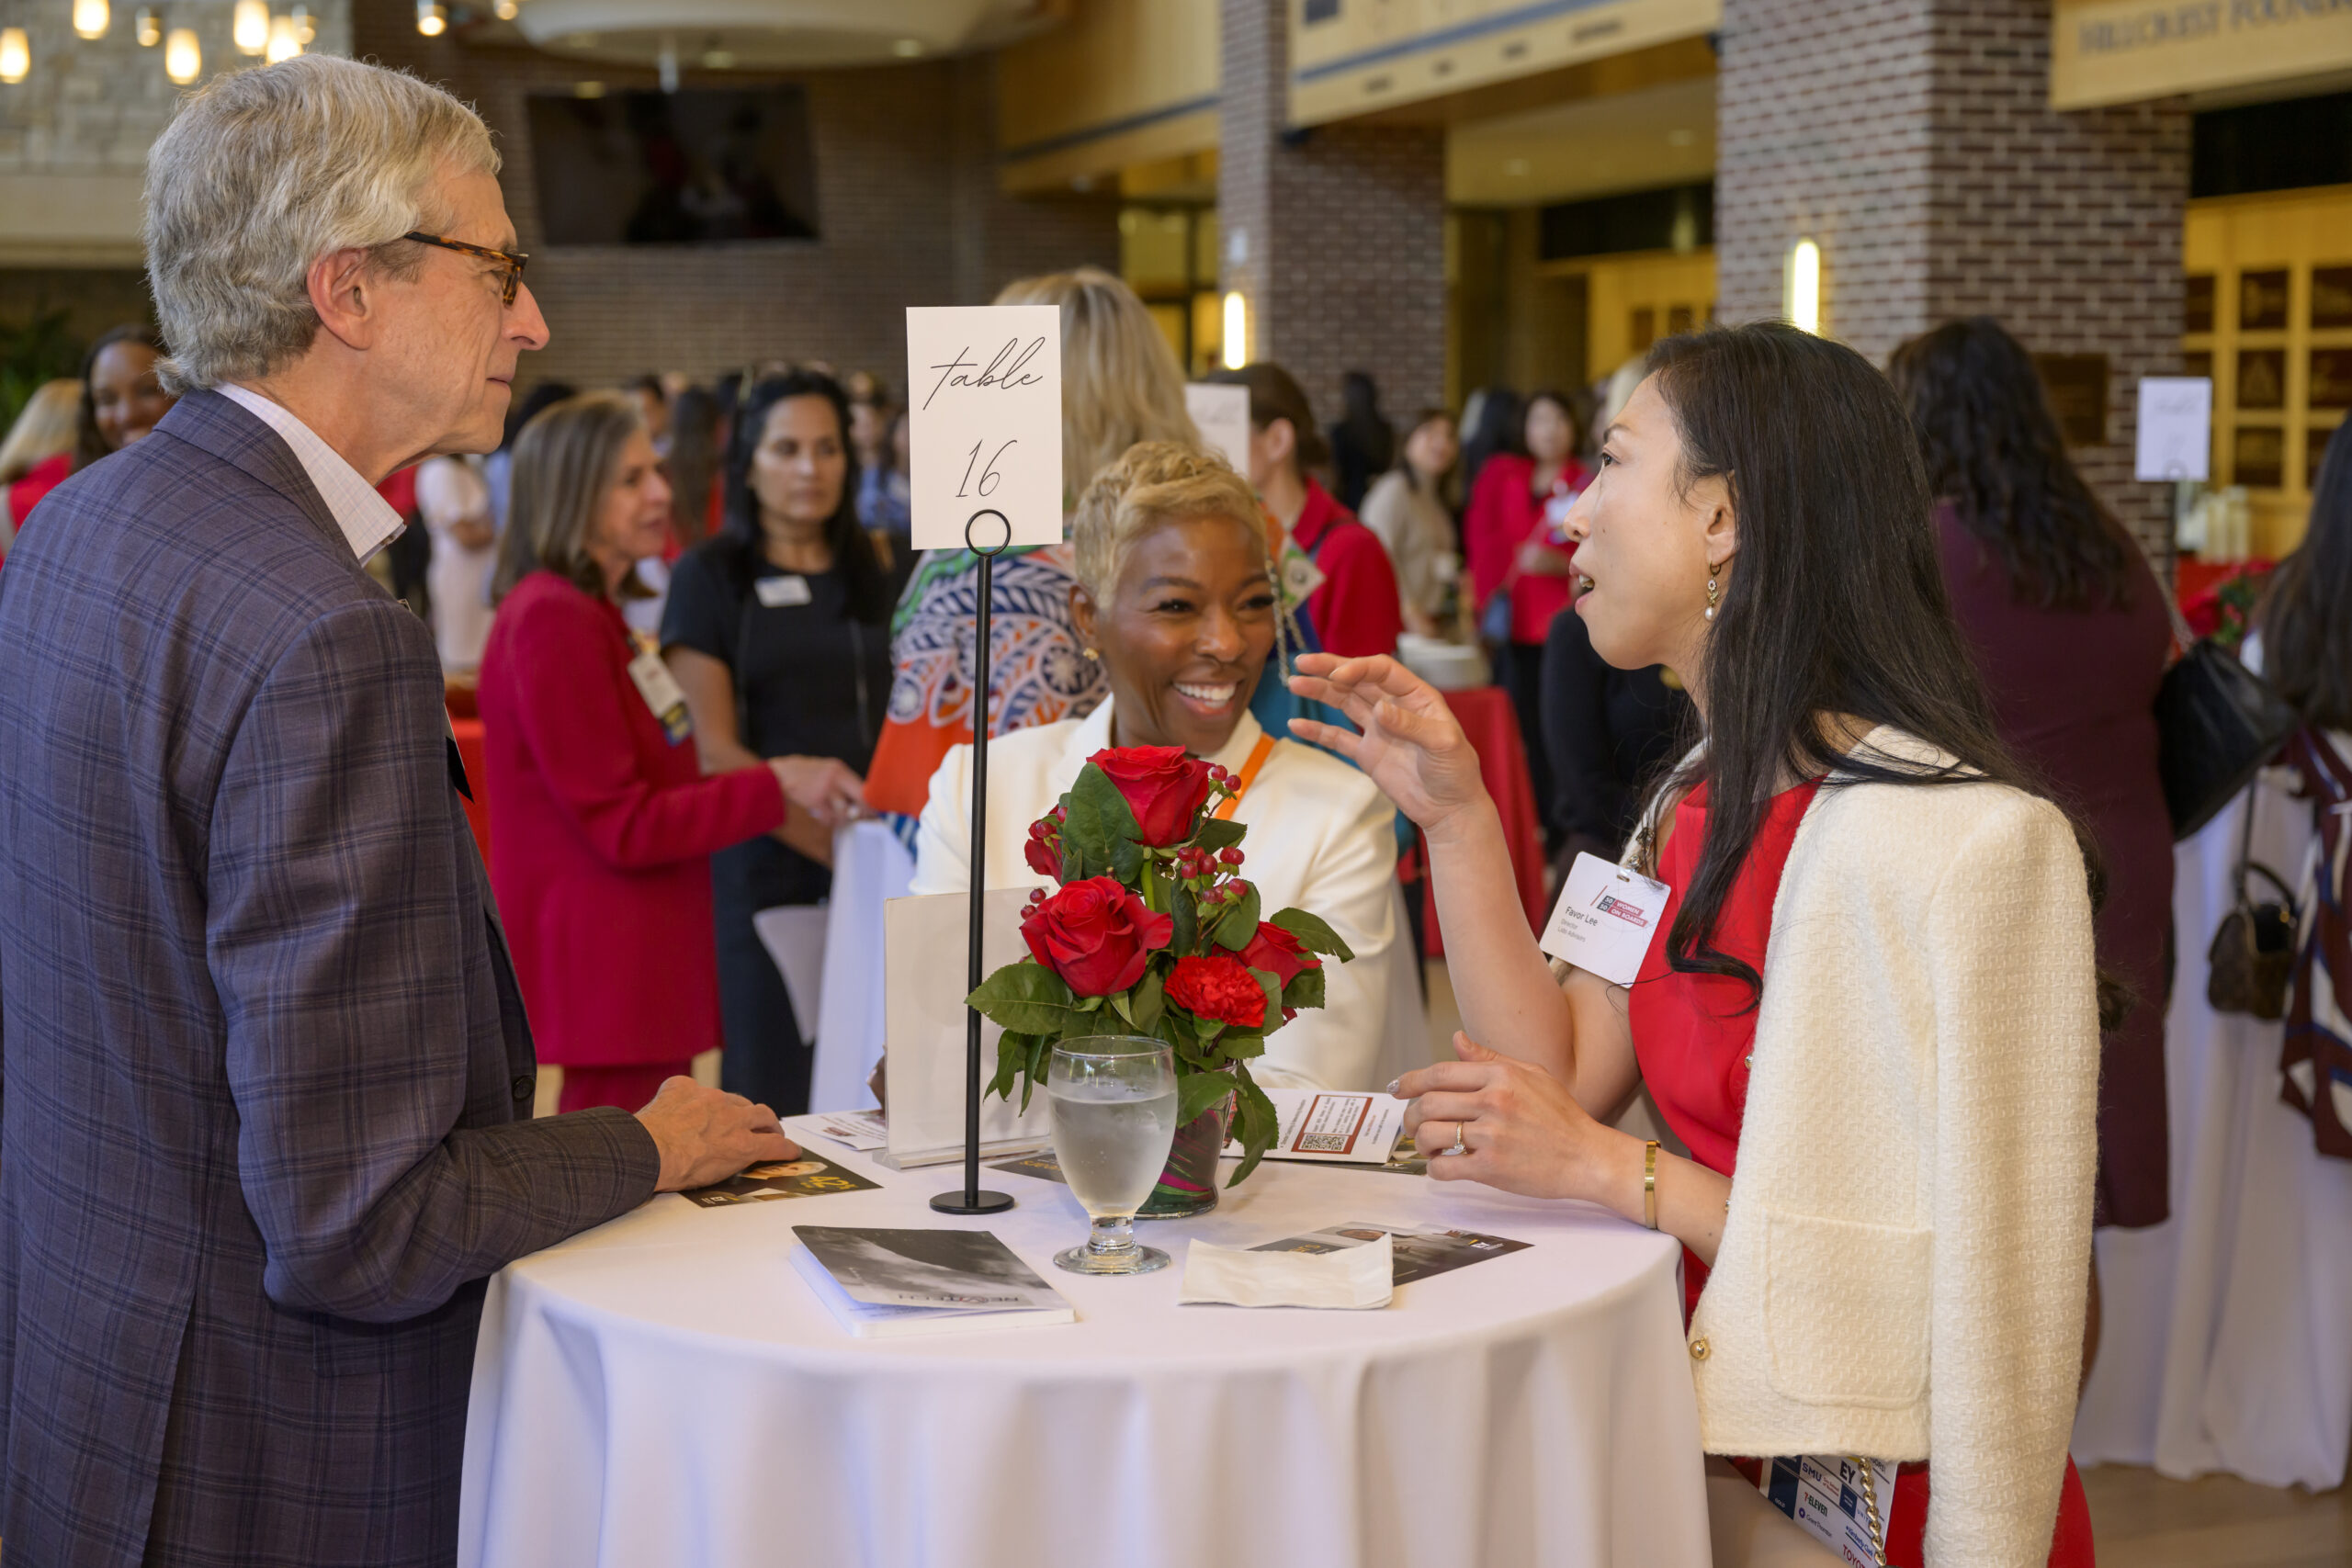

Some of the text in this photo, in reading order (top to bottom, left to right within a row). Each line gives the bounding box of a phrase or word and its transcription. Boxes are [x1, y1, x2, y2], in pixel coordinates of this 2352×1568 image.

[922, 336, 1046, 411] table
[956, 439, 1017, 498] 16
[1566, 906, 1599, 927] Favor Lee
[1611, 908, 1621, 918] ON
[1621, 911, 1645, 927] BOARDS
[1616, 901, 1640, 915] WOMEN
[1802, 1462, 1822, 1483] SMU
[1839, 1460, 1856, 1484] EY
